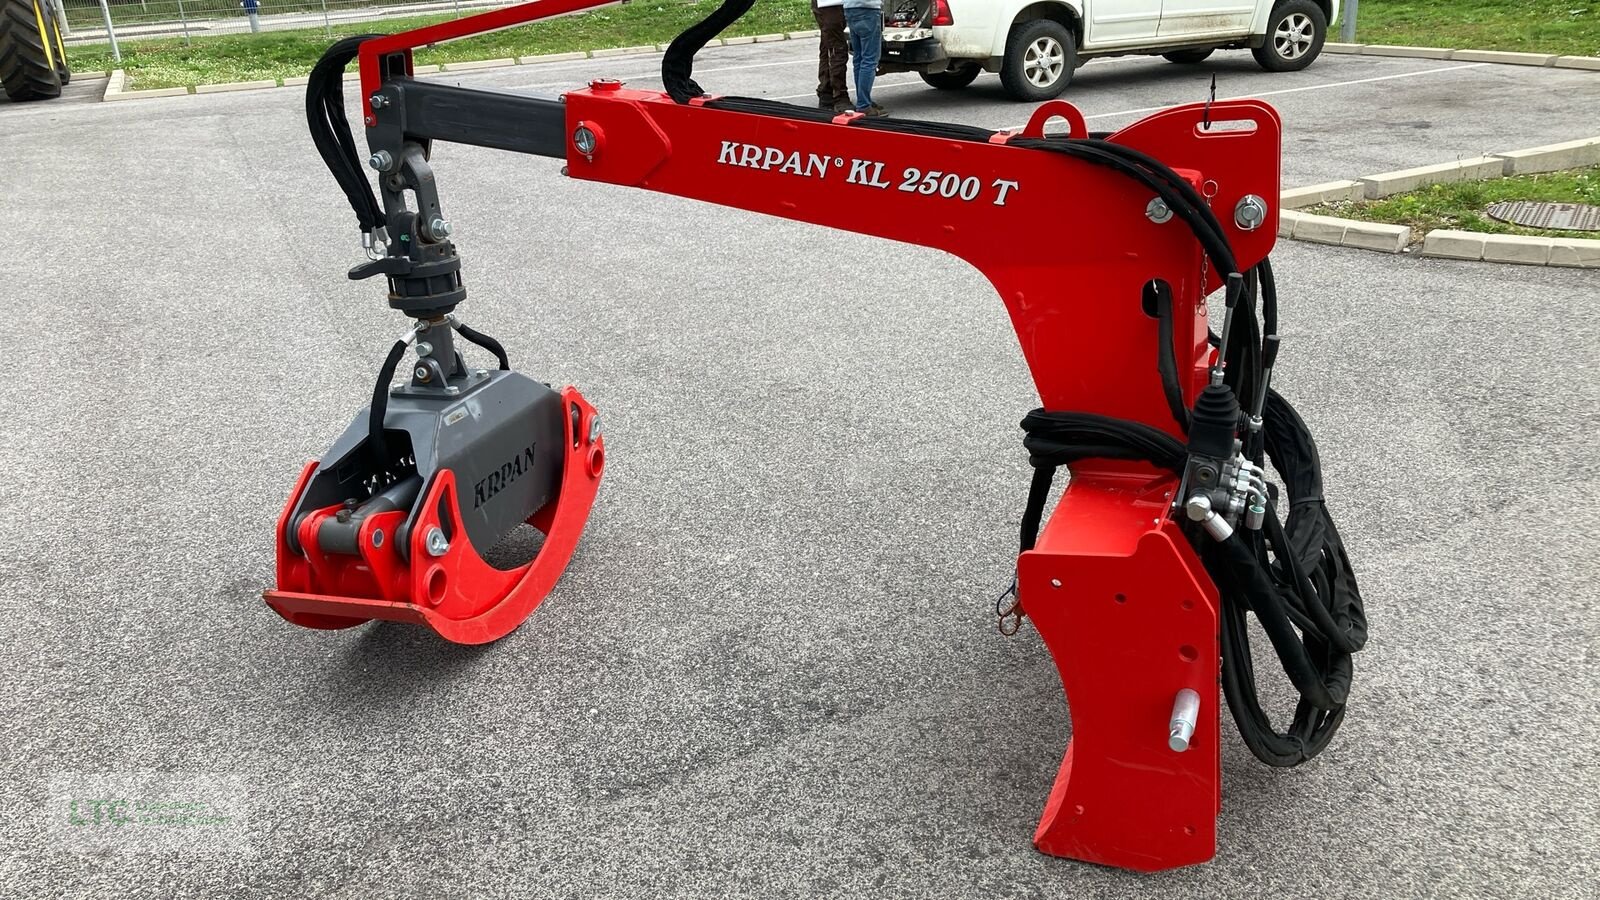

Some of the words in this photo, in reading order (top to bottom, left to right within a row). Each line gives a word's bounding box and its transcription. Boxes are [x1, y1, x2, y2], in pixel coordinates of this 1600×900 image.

[846, 159, 890, 189] KL
[898, 167, 981, 202] 2500
[991, 178, 1020, 207] T
[474, 441, 537, 511] KRPAN
